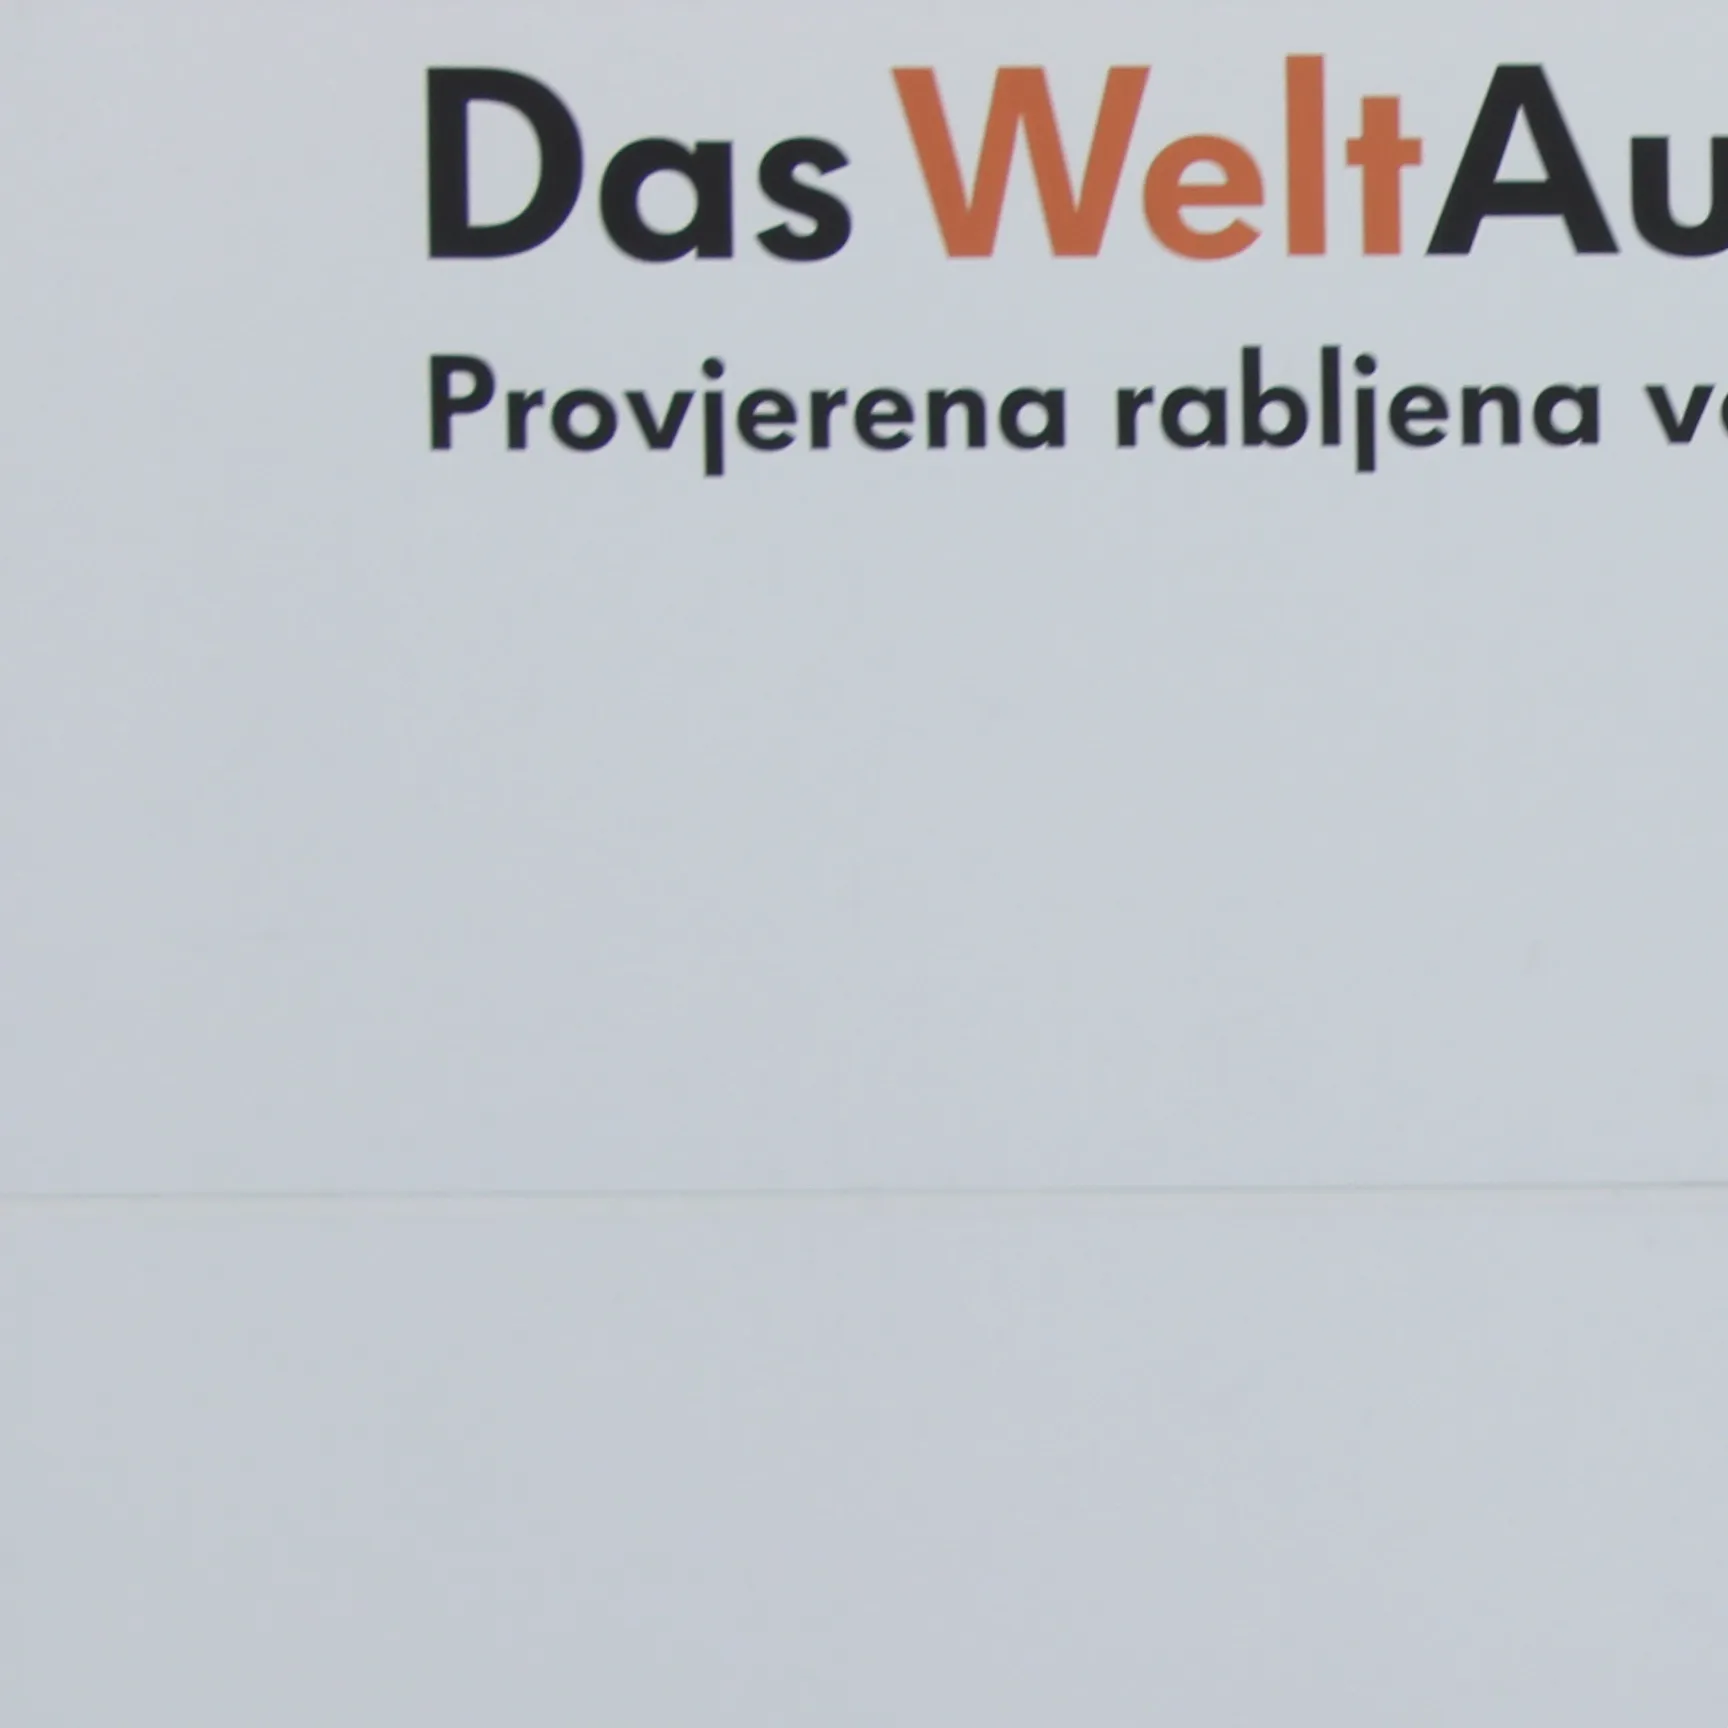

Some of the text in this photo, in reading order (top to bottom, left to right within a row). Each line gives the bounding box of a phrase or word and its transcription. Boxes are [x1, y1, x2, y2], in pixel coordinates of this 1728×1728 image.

[426, 65, 853, 264] Das
[428, 353, 1067, 478] Provjerena
[1115, 345, 1601, 474] rabljena
